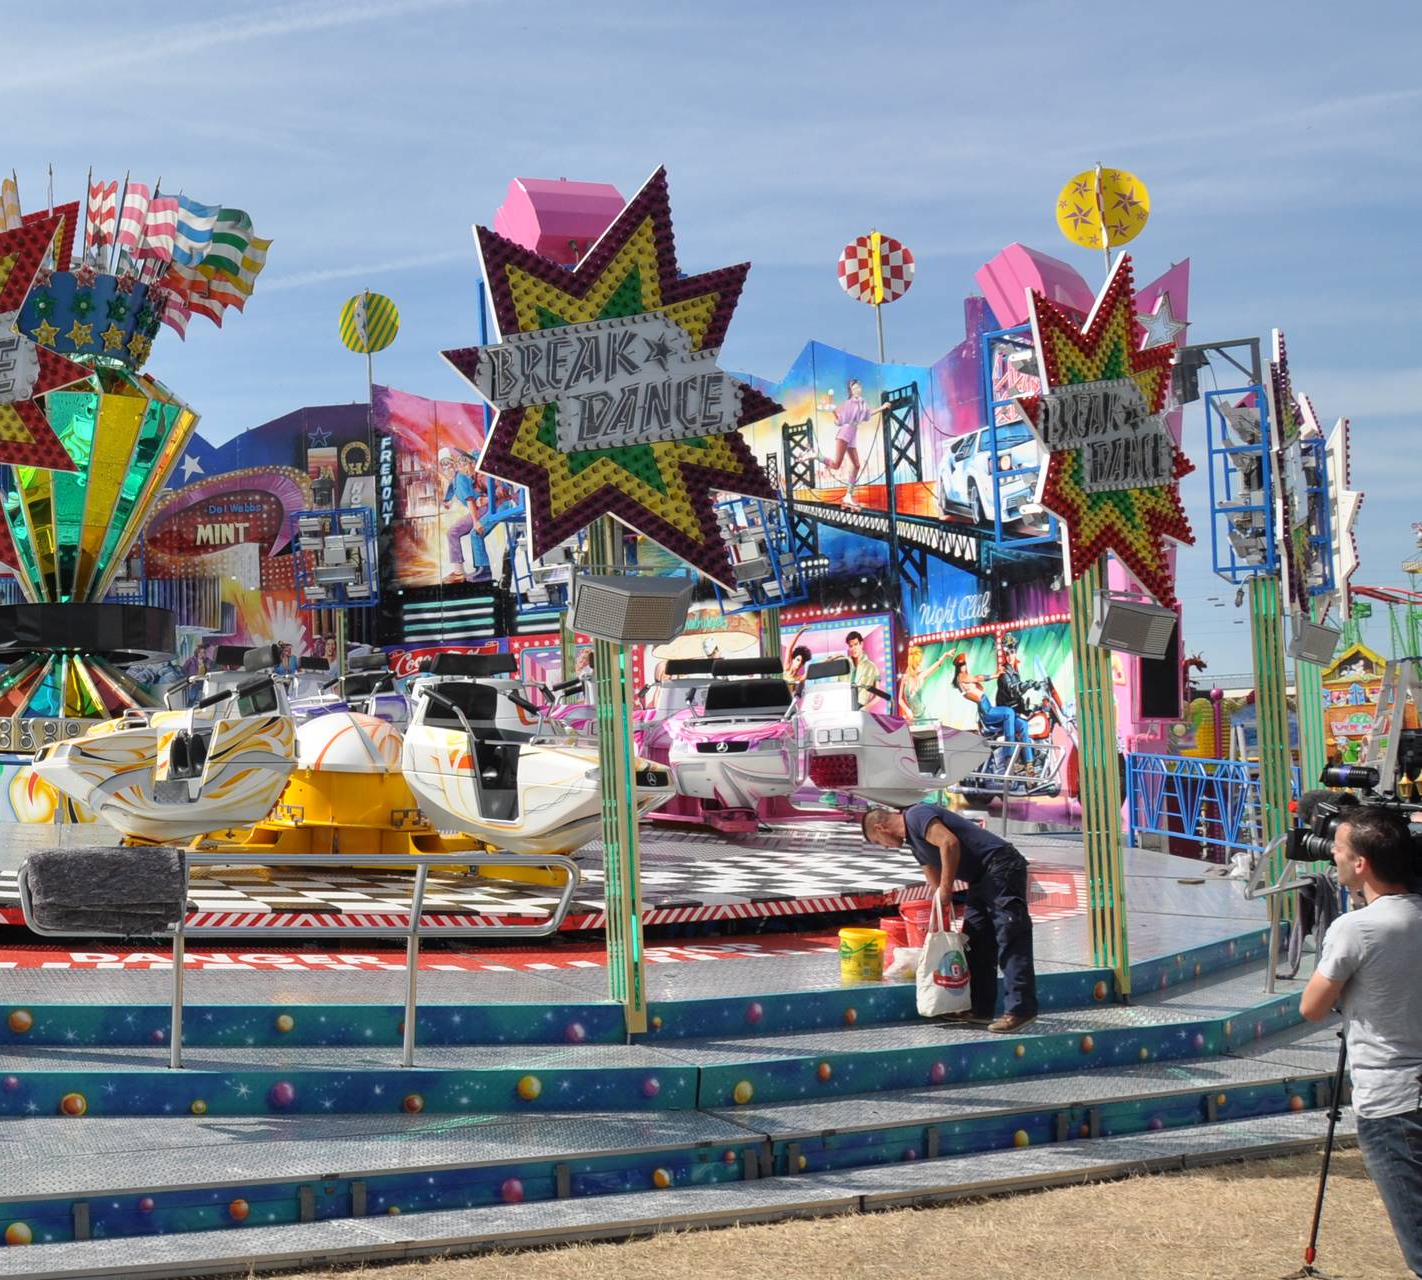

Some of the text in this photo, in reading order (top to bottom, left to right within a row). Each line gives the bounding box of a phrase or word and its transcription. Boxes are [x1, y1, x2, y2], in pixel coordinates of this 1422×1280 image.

[486, 330, 642, 400] BREAK
[566, 371, 725, 442] DANCE
[1043, 391, 1126, 443] BREAK
[379, 436, 395, 526] FREMONT
[1087, 433, 1171, 483] DANCE
[195, 521, 250, 546] MINT
[919, 591, 992, 627] Night Club
[69, 952, 391, 966] DANGER
